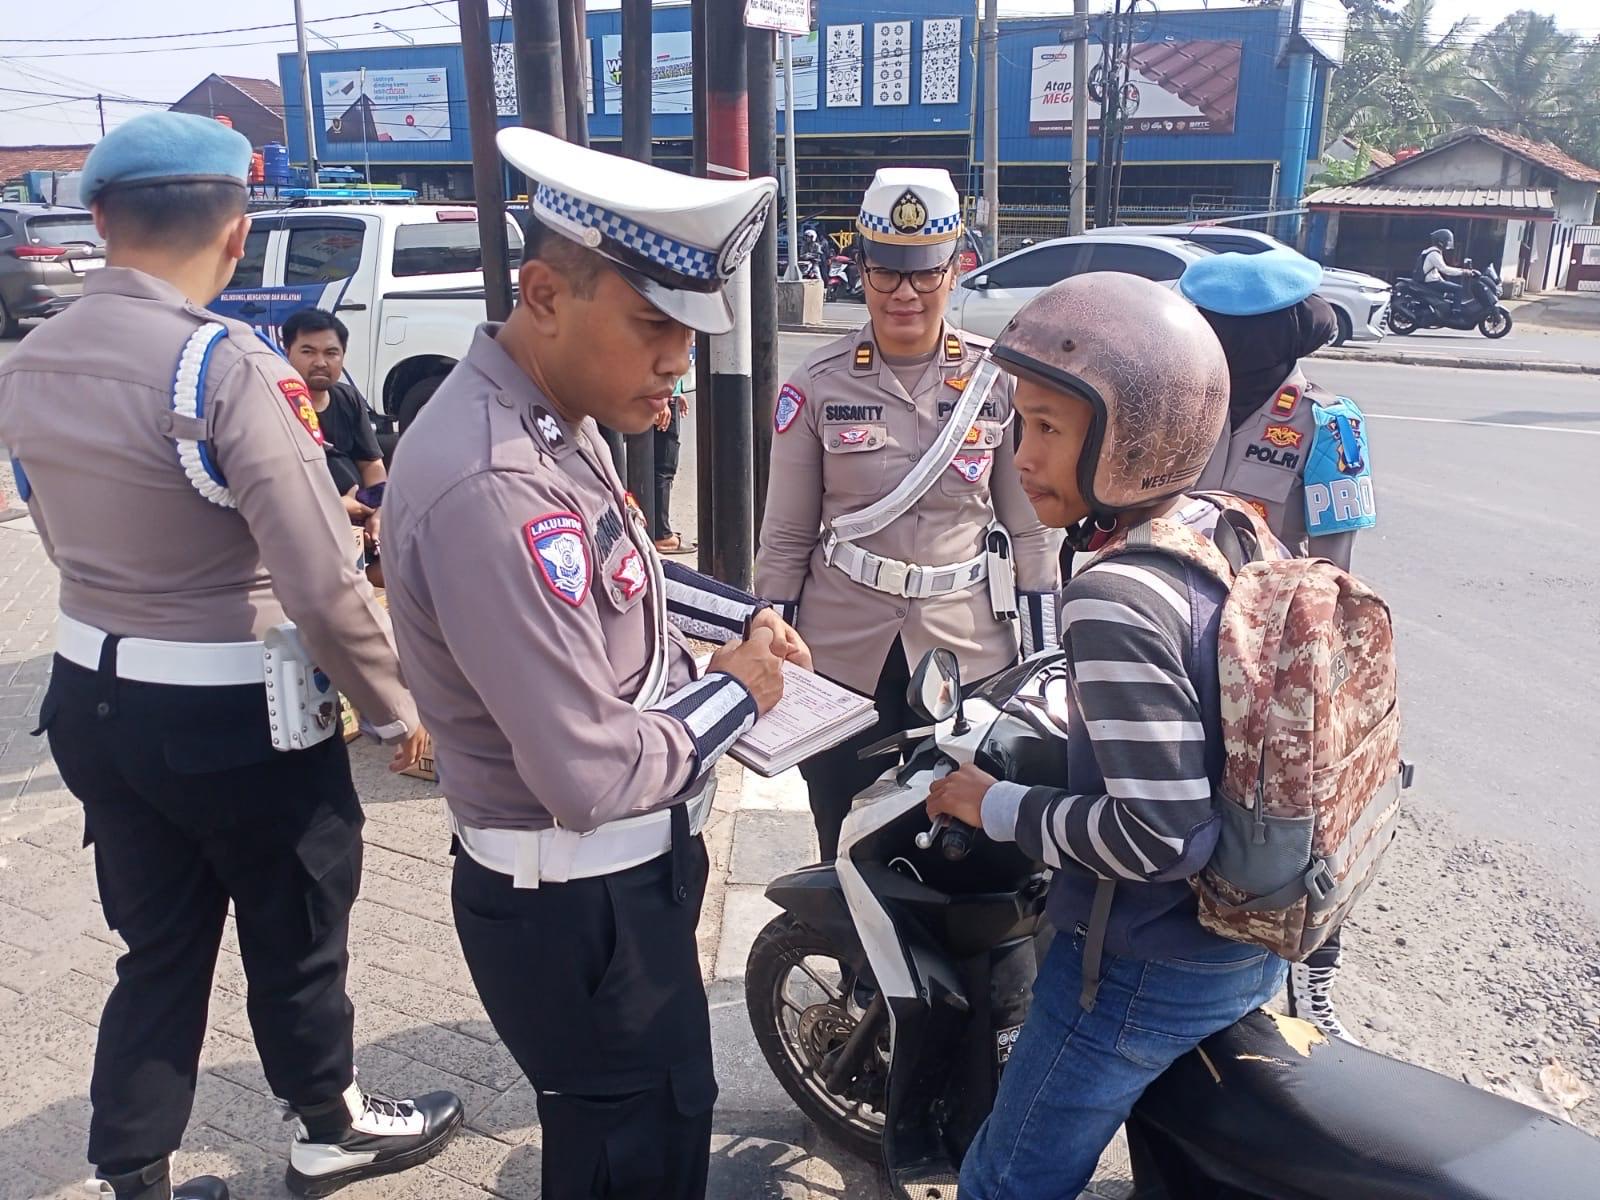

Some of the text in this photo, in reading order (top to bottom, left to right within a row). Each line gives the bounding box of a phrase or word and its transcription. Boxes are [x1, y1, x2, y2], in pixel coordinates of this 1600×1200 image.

[1044, 81, 1072, 93] Atap
[825, 405, 884, 421] SUSANTY
[938, 401, 997, 418] PRI
[1245, 444, 1300, 469] POLRI
[1141, 473, 1174, 489] WEST
